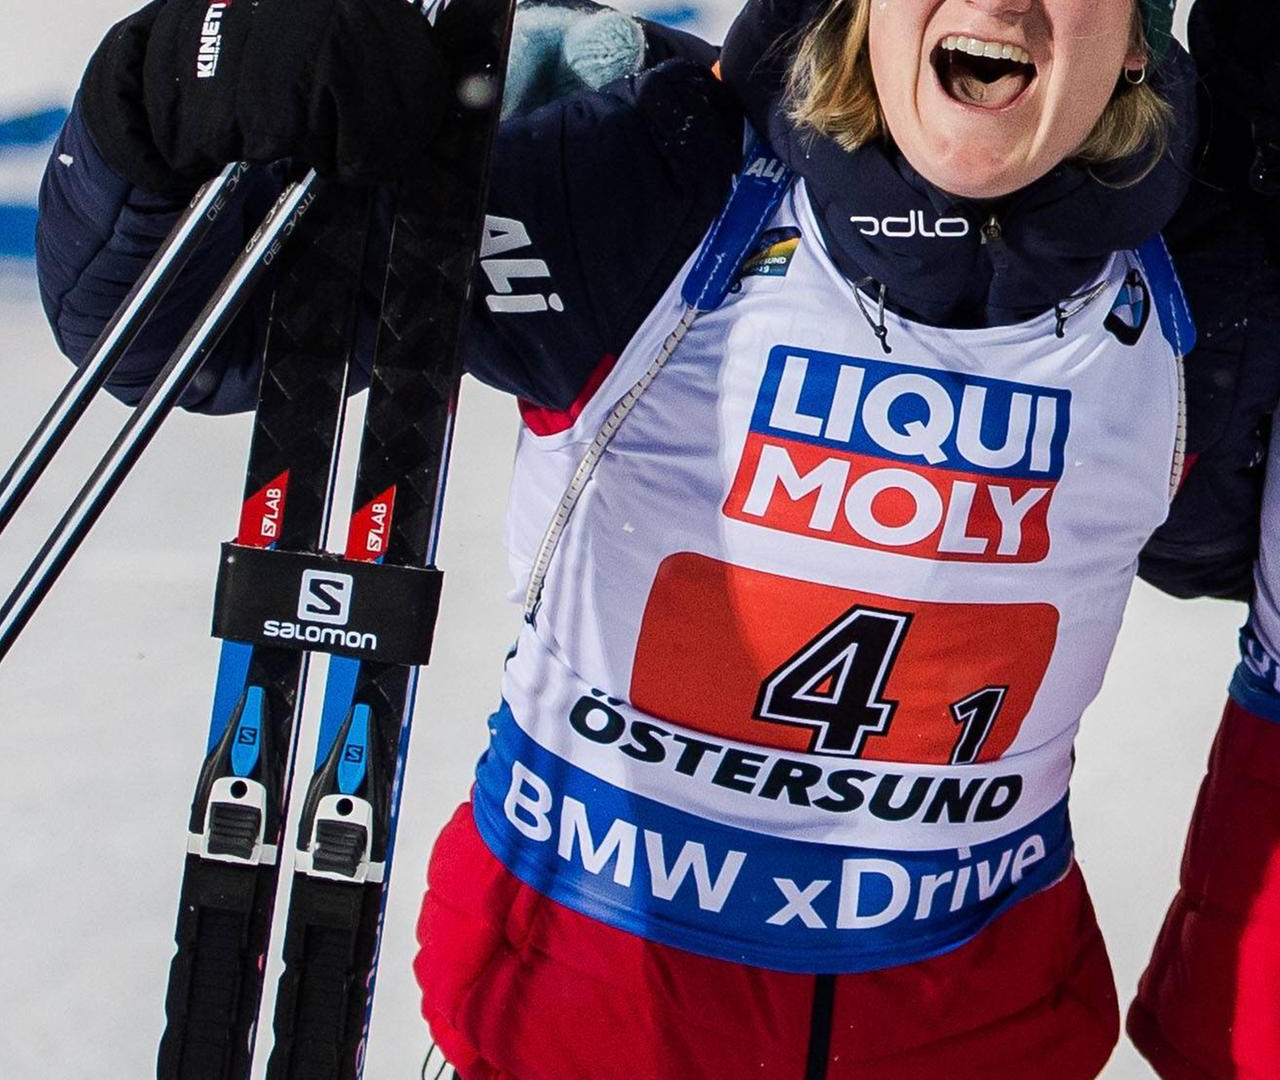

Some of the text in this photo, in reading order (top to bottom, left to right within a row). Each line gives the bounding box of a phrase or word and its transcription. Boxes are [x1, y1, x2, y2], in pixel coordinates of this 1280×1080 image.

[769, 354, 1057, 473] LIQUI
[743, 446, 1050, 556] MOLY
[263, 619, 378, 651] salomon
[752, 603, 914, 759] 4
[567, 686, 1023, 825] ÖSTERSUND
[950, 684, 1009, 765] 1
[502, 761, 1047, 931] BMW xDrive
